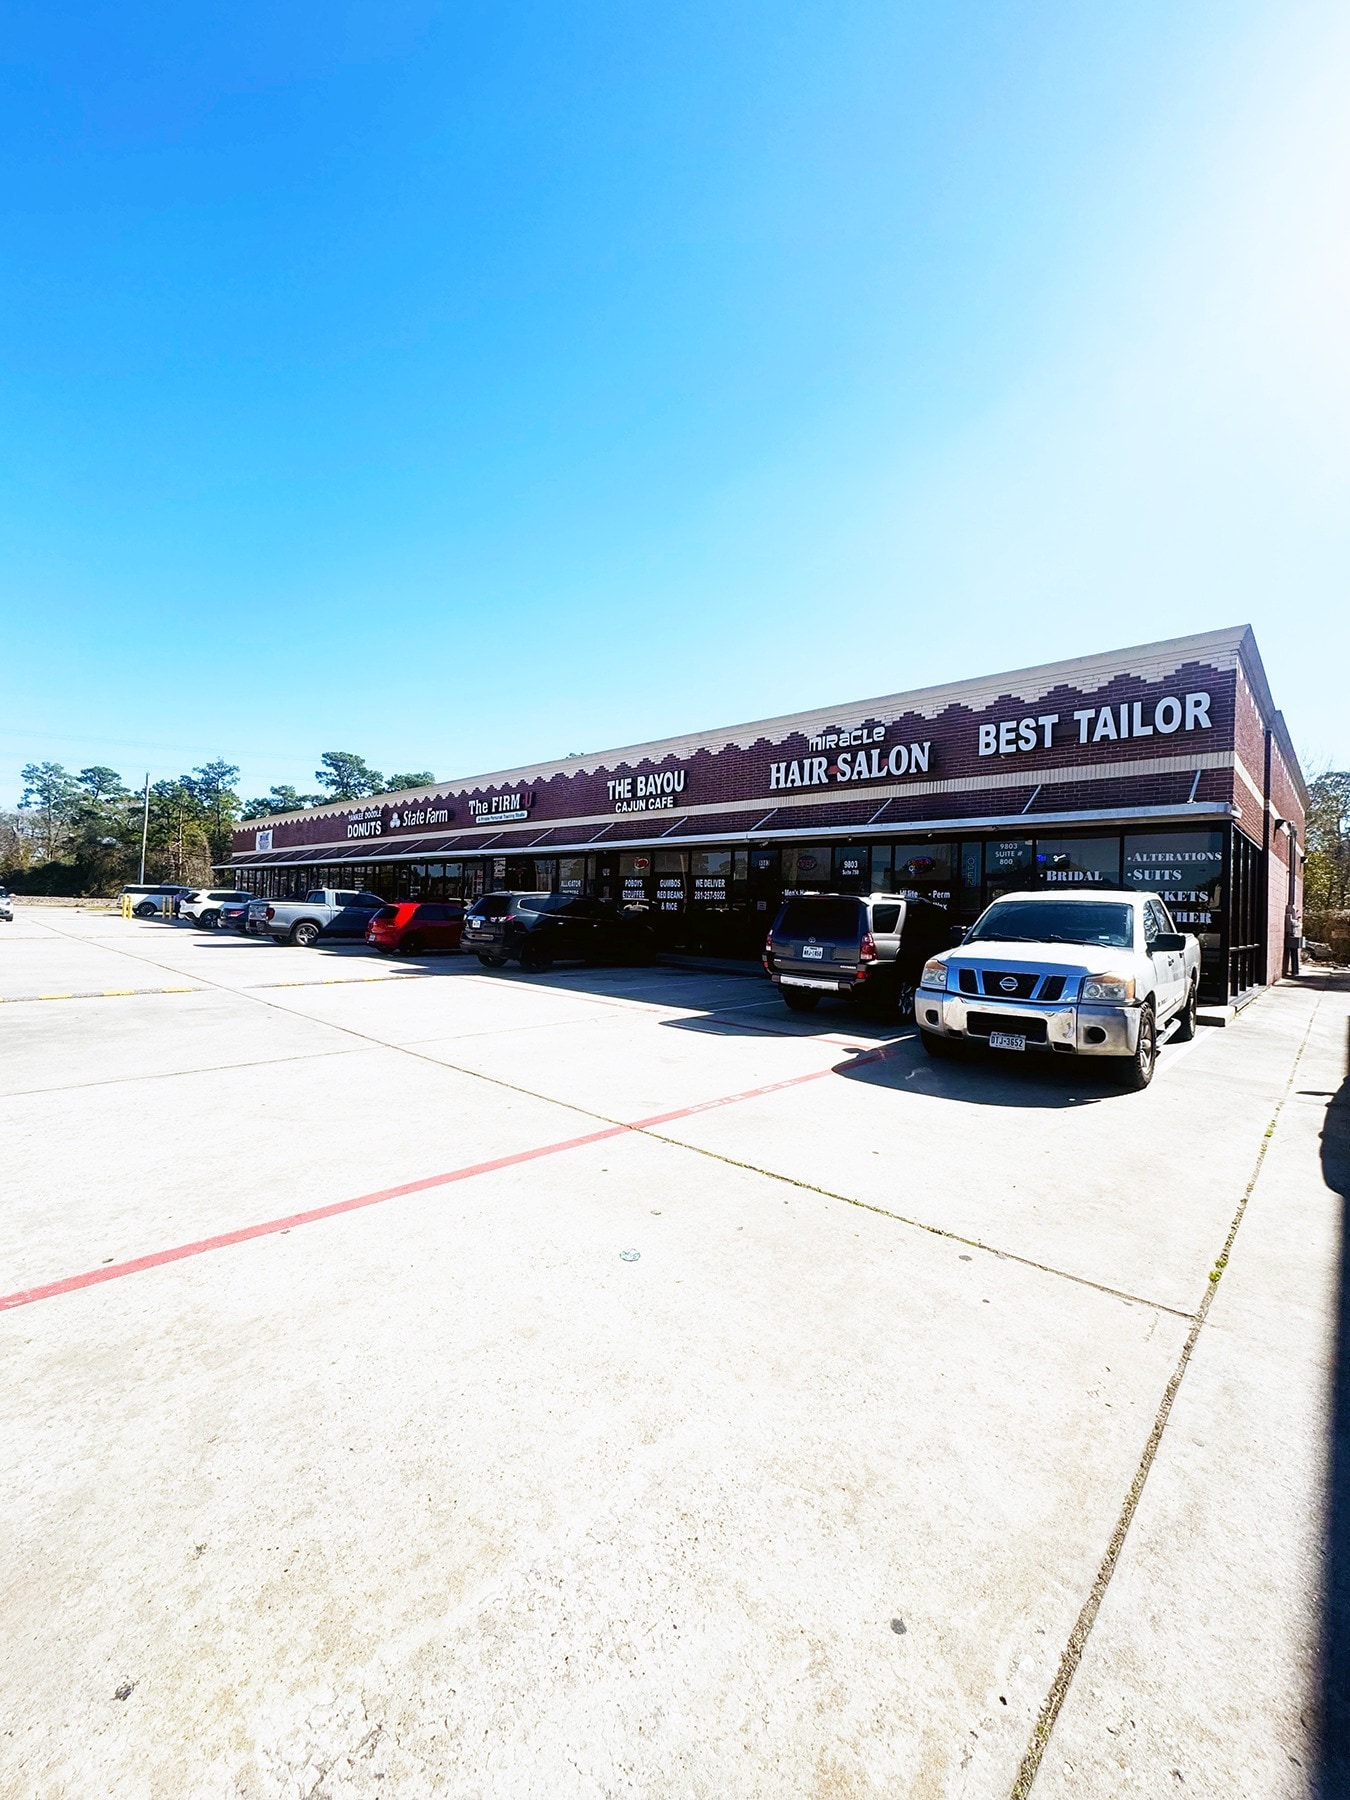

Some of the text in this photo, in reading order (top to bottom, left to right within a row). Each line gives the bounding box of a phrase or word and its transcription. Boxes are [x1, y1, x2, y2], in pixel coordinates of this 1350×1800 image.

[978, 691, 1212, 757] BEST TAILOR
[769, 741, 931, 790] HAIR SALON
[607, 769, 685, 800] THE BAYOU
[468, 800, 488, 815] The
[491, 793, 521, 813] FIRM
[615, 795, 674, 813] CAJUN CAFE
[364, 810, 382, 819] DOODLE
[402, 807, 448, 827] State Farm
[347, 821, 382, 838] DONUTS
[1132, 852, 1222, 862] ALTERATIONS
[1046, 870, 1104, 881] BRIDAL
[1133, 868, 1182, 881] SUITS
[660, 879, 681, 887] GUMBOS
[695, 879, 726, 887] WE DELIVER
[657, 890, 684, 899] RED BEANS
[932, 890, 951, 899] Perm
[665, 902, 678, 911] RICE
